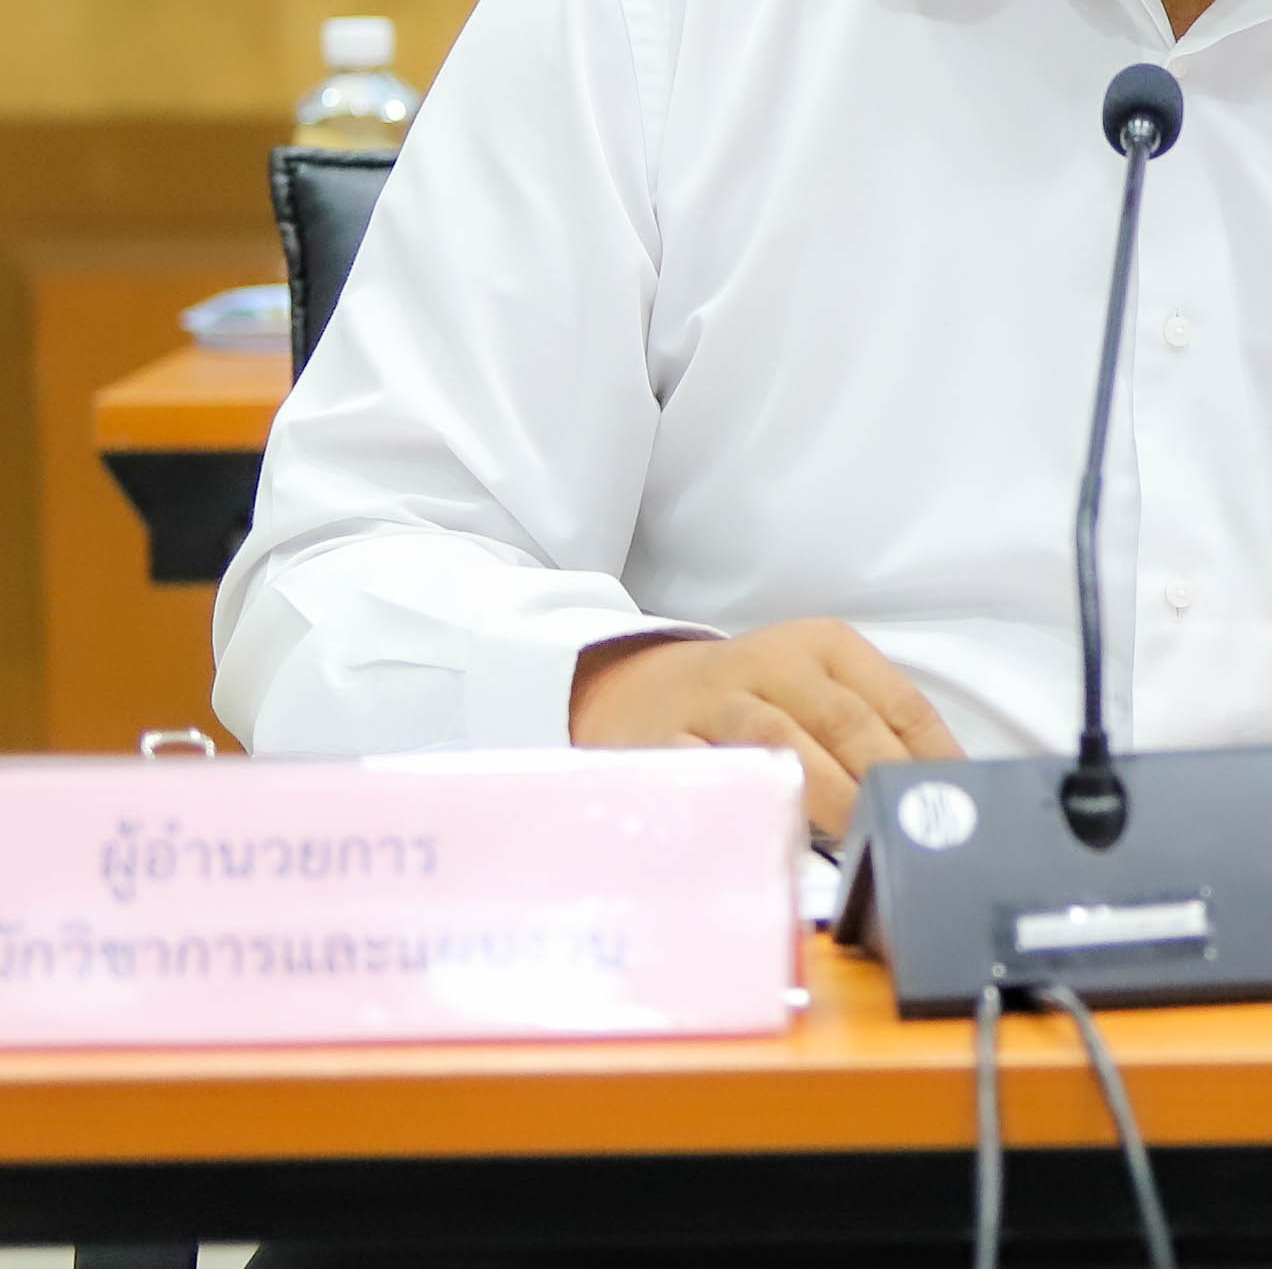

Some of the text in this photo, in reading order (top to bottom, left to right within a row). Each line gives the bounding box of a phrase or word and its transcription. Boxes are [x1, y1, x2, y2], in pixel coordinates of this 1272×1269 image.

[100, 816, 440, 904] ผู้อำนวยการ
